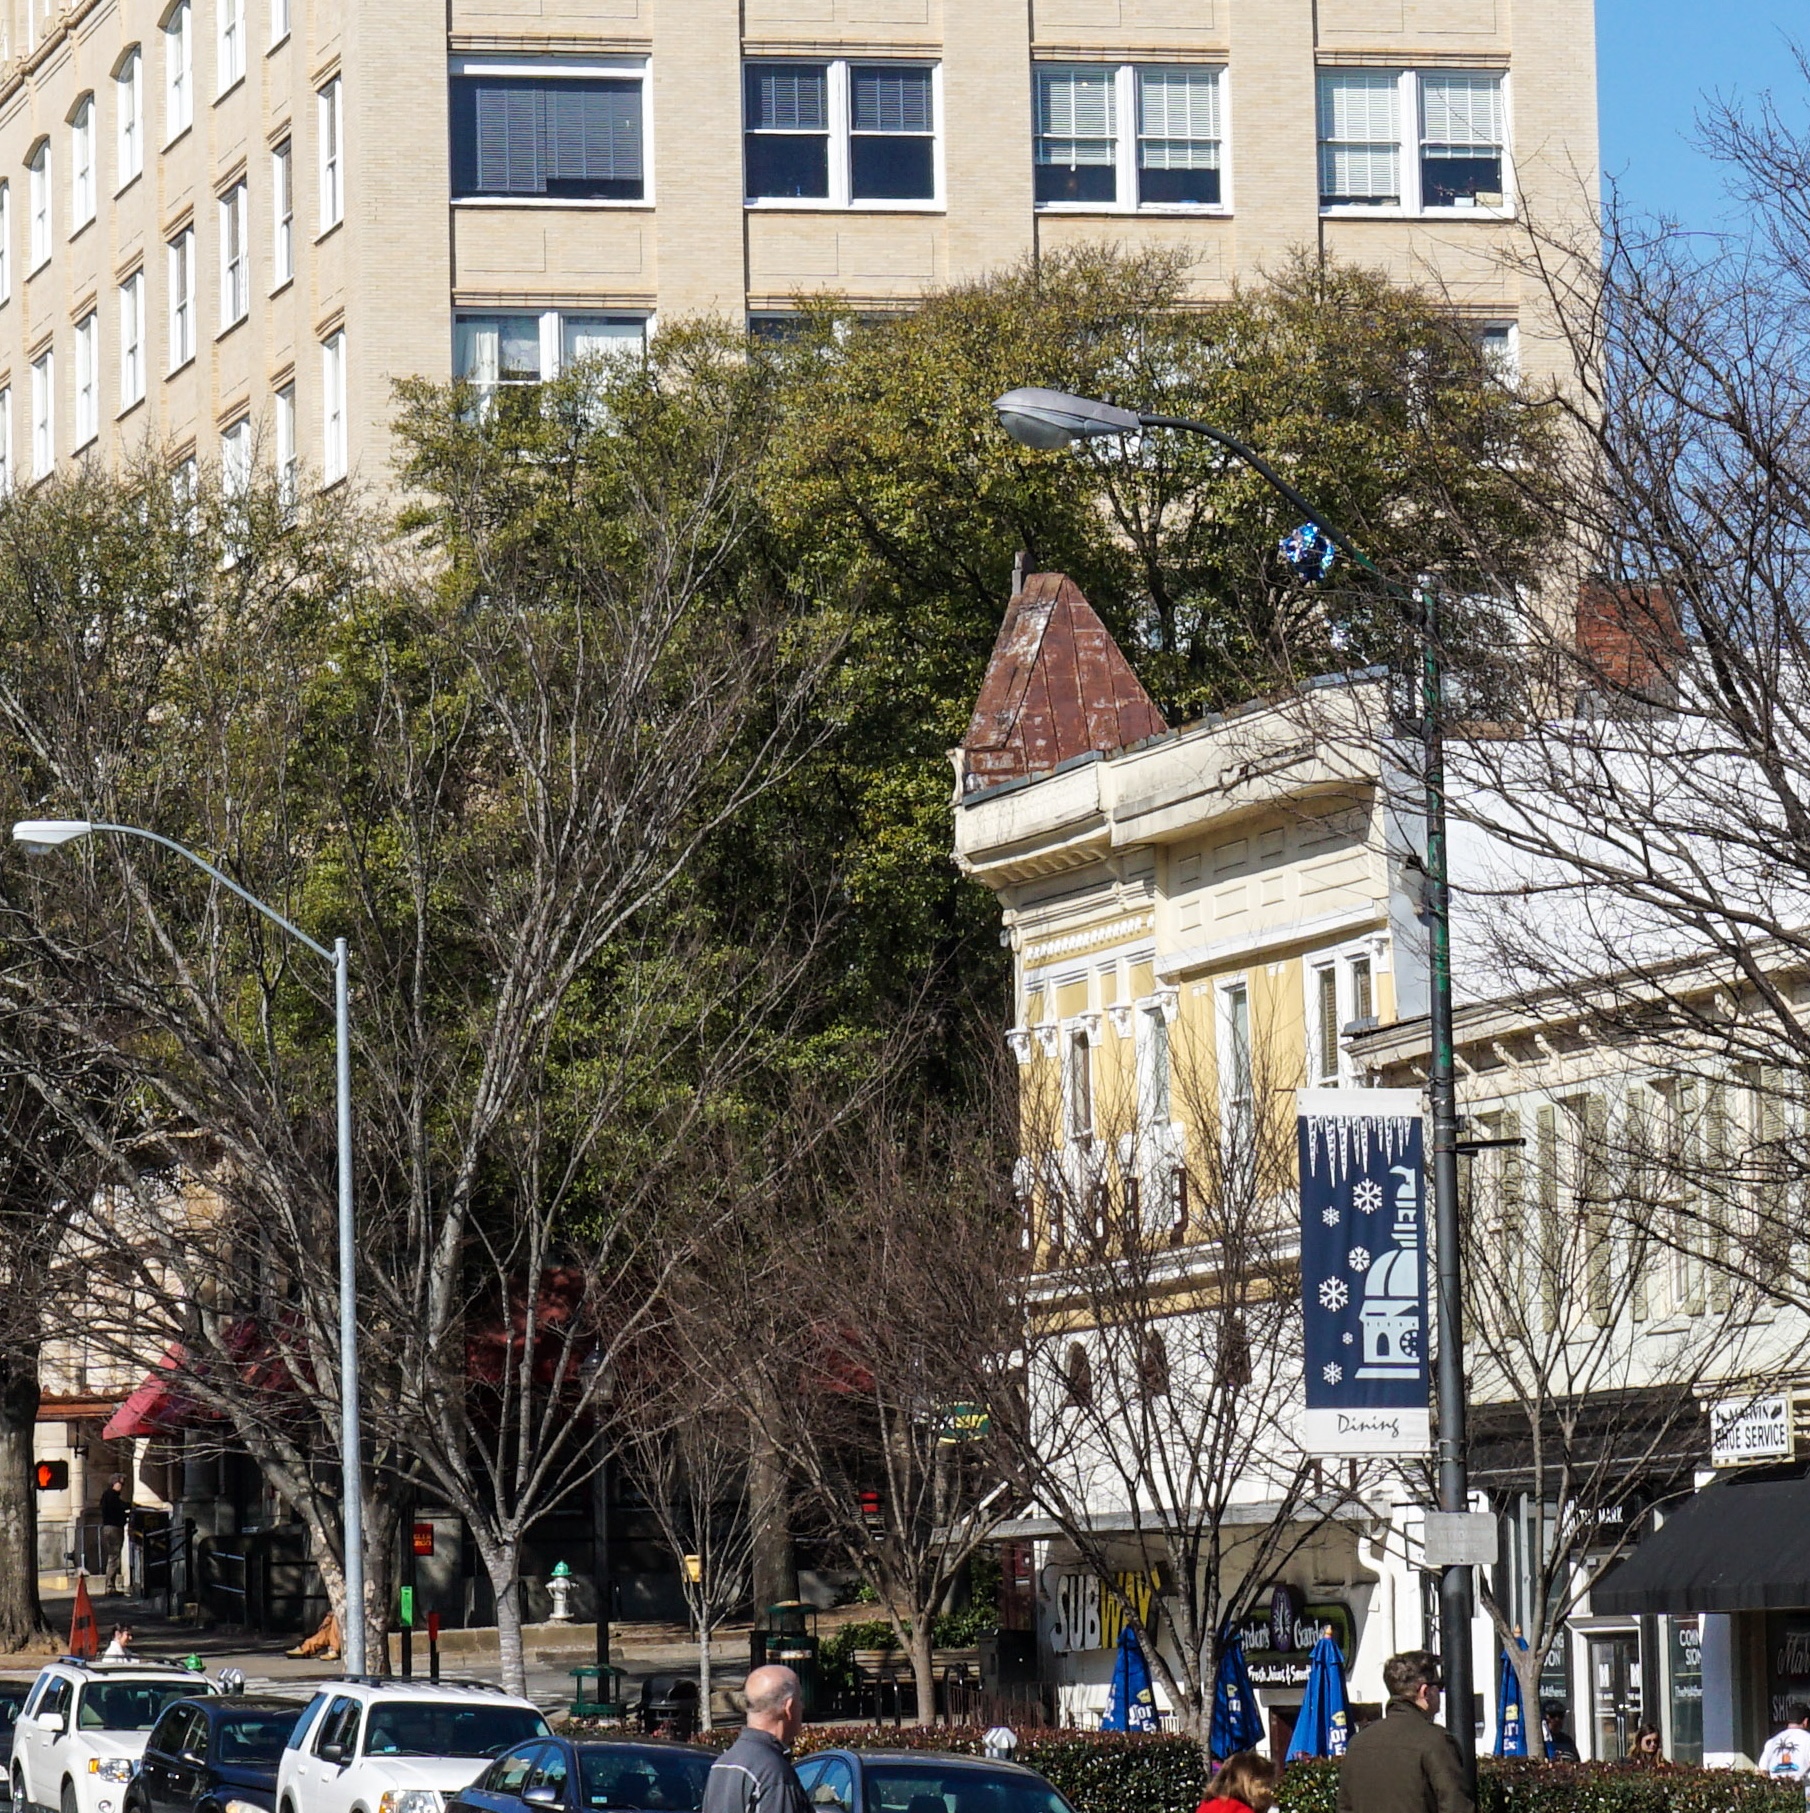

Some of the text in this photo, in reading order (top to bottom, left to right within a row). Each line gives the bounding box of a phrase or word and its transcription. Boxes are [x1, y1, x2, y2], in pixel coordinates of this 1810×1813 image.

[1337, 1413, 1399, 1438] Dining
[1745, 1423, 1785, 1449] SERVICE
[1241, 1622, 1270, 1650] rden's
[1247, 1665, 1266, 1682] Fresh
